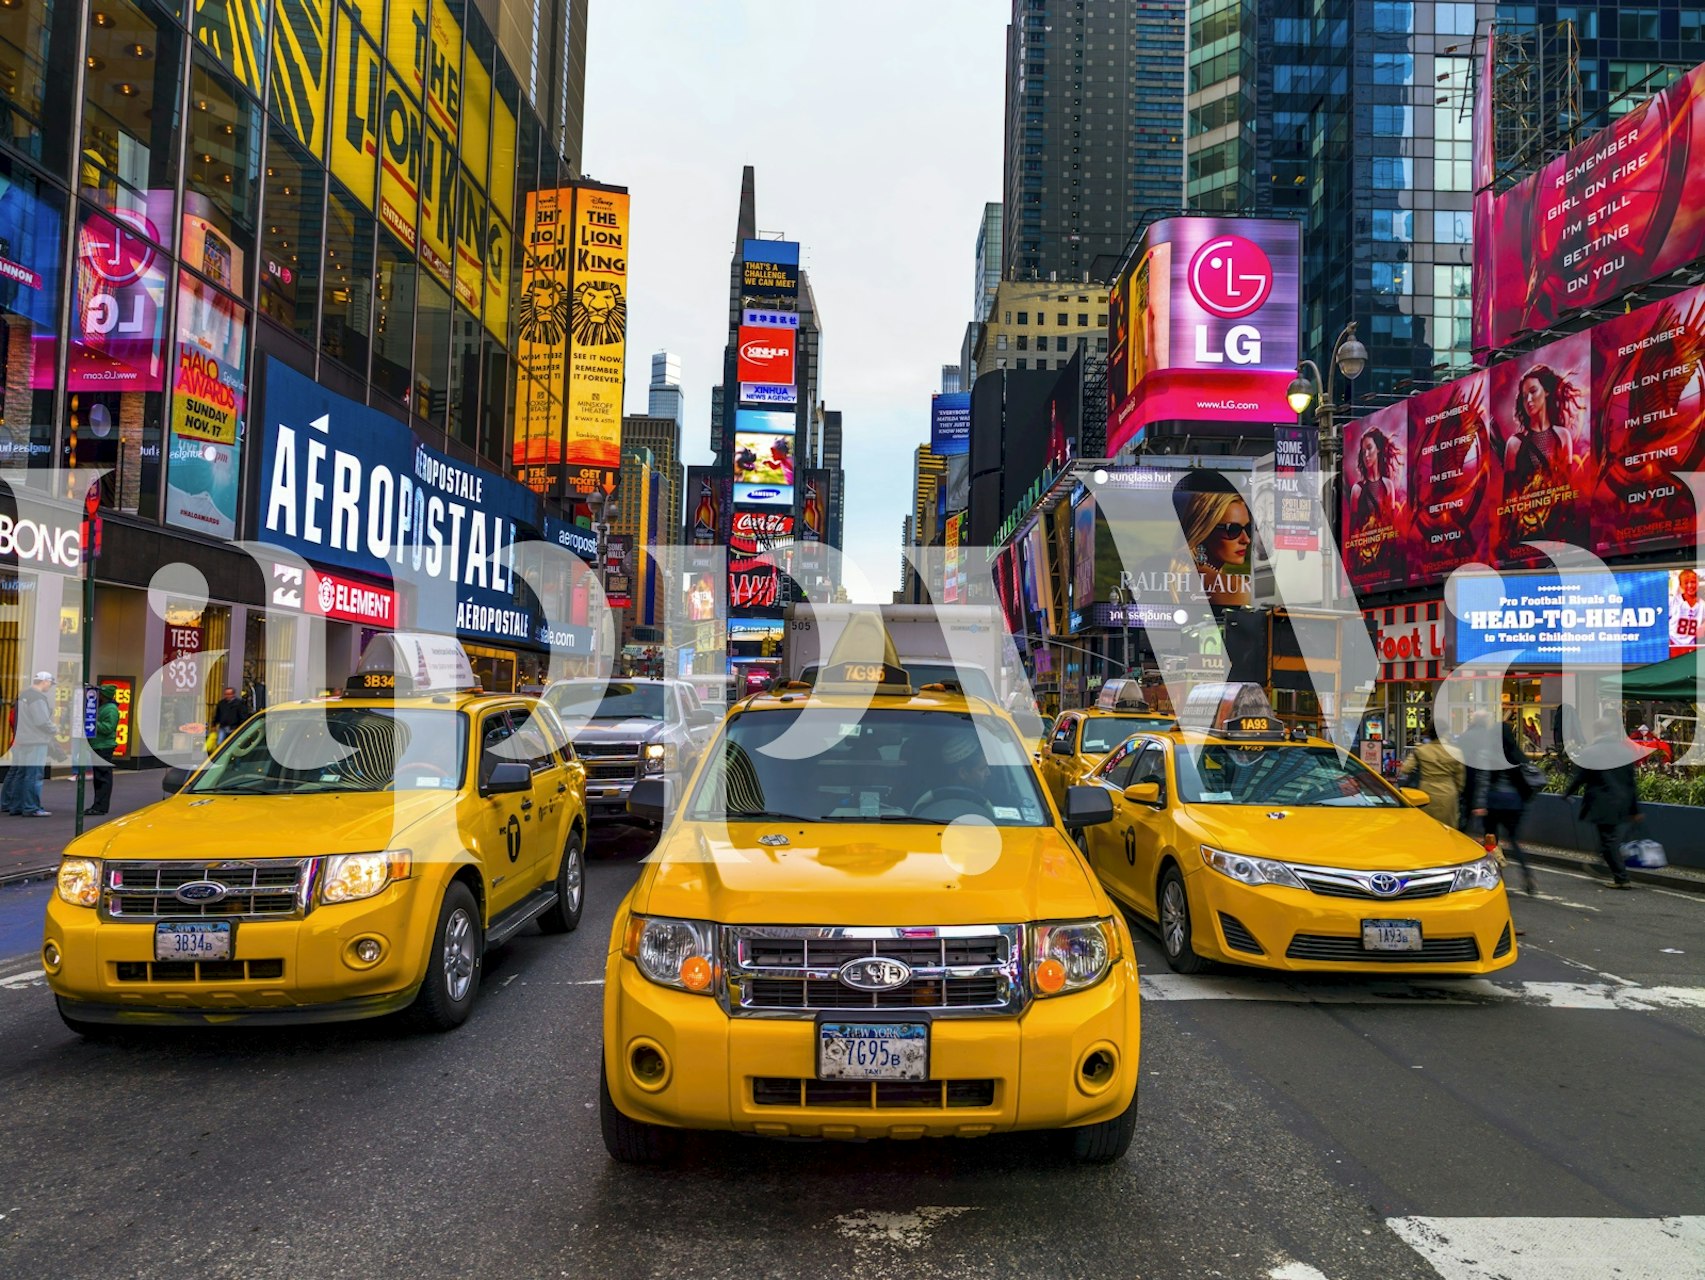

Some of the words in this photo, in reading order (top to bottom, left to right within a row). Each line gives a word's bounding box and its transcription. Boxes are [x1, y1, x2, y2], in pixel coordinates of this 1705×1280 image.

[411, 8, 459, 125] THE
[346, 2, 435, 204] LION
[1555, 128, 1639, 189] REMEMBER
[1547, 196, 1580, 222] GIRL
[1585, 178, 1607, 199] ON
[1612, 152, 1649, 184] FIRE
[437, 127, 503, 284] KING
[590, 195, 614, 208] Disney
[382, 201, 416, 245] ENTRANCE
[586, 210, 617, 225] THE
[1562, 219, 1583, 240] I'M
[1587, 195, 1632, 226] STILL
[581, 225, 622, 246] LION
[422, 244, 433, 262] ON
[1563, 224, 1630, 268] BETTING
[577, 248, 626, 272] KING
[745, 261, 771, 271] THAT'S
[772, 263, 779, 272] A
[744, 269, 787, 280] CHALLENGE
[744, 277, 757, 286] WE
[758, 278, 774, 287] CAN
[775, 279, 797, 289] MEET
[1567, 273, 1589, 294] ON
[1593, 255, 1625, 281] YOU
[1194, 324, 1262, 365] LG
[1617, 325, 1685, 358] REMEMBER
[599, 355, 623, 364] NOW.
[747, 346, 789, 357] XINHUA
[179, 347, 220, 381] HALO
[575, 364, 619, 375] REMEMBER
[583, 374, 622, 385] FOREVER.
[1612, 382, 1639, 396] GIRL
[1641, 375, 1659, 387] ON
[1662, 362, 1690, 381] FIRE
[177, 373, 236, 410] AWARDS
[745, 393, 767, 401] NEWS
[767, 394, 797, 402] AGENCY
[753, 385, 789, 396] XINHUA
[186, 398, 228, 425] SUNDAY
[577, 400, 614, 409] MINSKOFF
[581, 406, 610, 415] THEATRE
[1196, 400, 1259, 411] www.LG.com
[1424, 403, 1469, 425] REMEMBER
[1624, 416, 1641, 430] I'M
[1642, 408, 1678, 425] STILL
[184, 414, 210, 434] NOV.
[211, 425, 222, 437] 17
[1276, 440, 1302, 454] SOME
[1421, 443, 1440, 456] GIRL
[1440, 440, 1452, 451] ON
[1453, 433, 1473, 449] FIRE
[1276, 453, 1307, 467] WALLS
[1624, 445, 1679, 467] BETTING
[415, 443, 483, 504] AÉROPOSTALE
[579, 468, 602, 478] GET
[1109, 471, 1153, 485] sunglass
[1154, 471, 1172, 483] hut
[1429, 474, 1440, 483] I'M
[1441, 468, 1464, 482] STILL
[1506, 495, 1517, 504] THE
[1518, 490, 1546, 501] HUNGER
[1546, 483, 1571, 496] GAMES
[1627, 490, 1647, 503] ON
[1647, 485, 1675, 499] YOU
[1281, 498, 1312, 510] SPOTLIGHT
[1428, 498, 1464, 514] BETTING
[1496, 496, 1551, 517] CATCHING
[1553, 489, 1580, 504] FIRE
[180, 508, 220, 526] #HALOAWARDS
[1361, 527, 1378, 537] HUNGER
[1615, 521, 1673, 537] NOVEMBER
[1674, 517, 1689, 528] 22
[0, 513, 81, 568] BONG
[1344, 535, 1381, 549] CATCHING
[1381, 530, 1399, 540] FIRE
[1430, 533, 1443, 544] ON
[1443, 530, 1461, 542] YOU
[607, 542, 624, 551] SOME
[607, 551, 626, 559] WALLS
[1119, 570, 1191, 593] RALPH
[1199, 572, 1251, 594] LAUR
[336, 587, 391, 620] ELEMENT
[1499, 596, 1518, 607] Pro
[1520, 595, 1566, 606] Football
[1568, 594, 1605, 605] Rivals
[1607, 594, 1624, 605] Go
[456, 597, 529, 638] AÉROPOSTALE
[791, 621, 812, 631] 505
[1676, 617, 1697, 636] 88
[170, 628, 199, 649] TEES
[1484, 632, 1496, 643] to
[1498, 632, 1536, 643] Tackle
[1538, 631, 1596, 642] Childhood
[1598, 631, 1640, 642] Cancer
[169, 662, 198, 688] $33
[363, 675, 396, 688] 3B34
[844, 664, 886, 682] 7G95
[1239, 717, 1268, 731] 1A93
[846, 1027, 871, 1038] NEW
[872, 1027, 901, 1039] YORK
